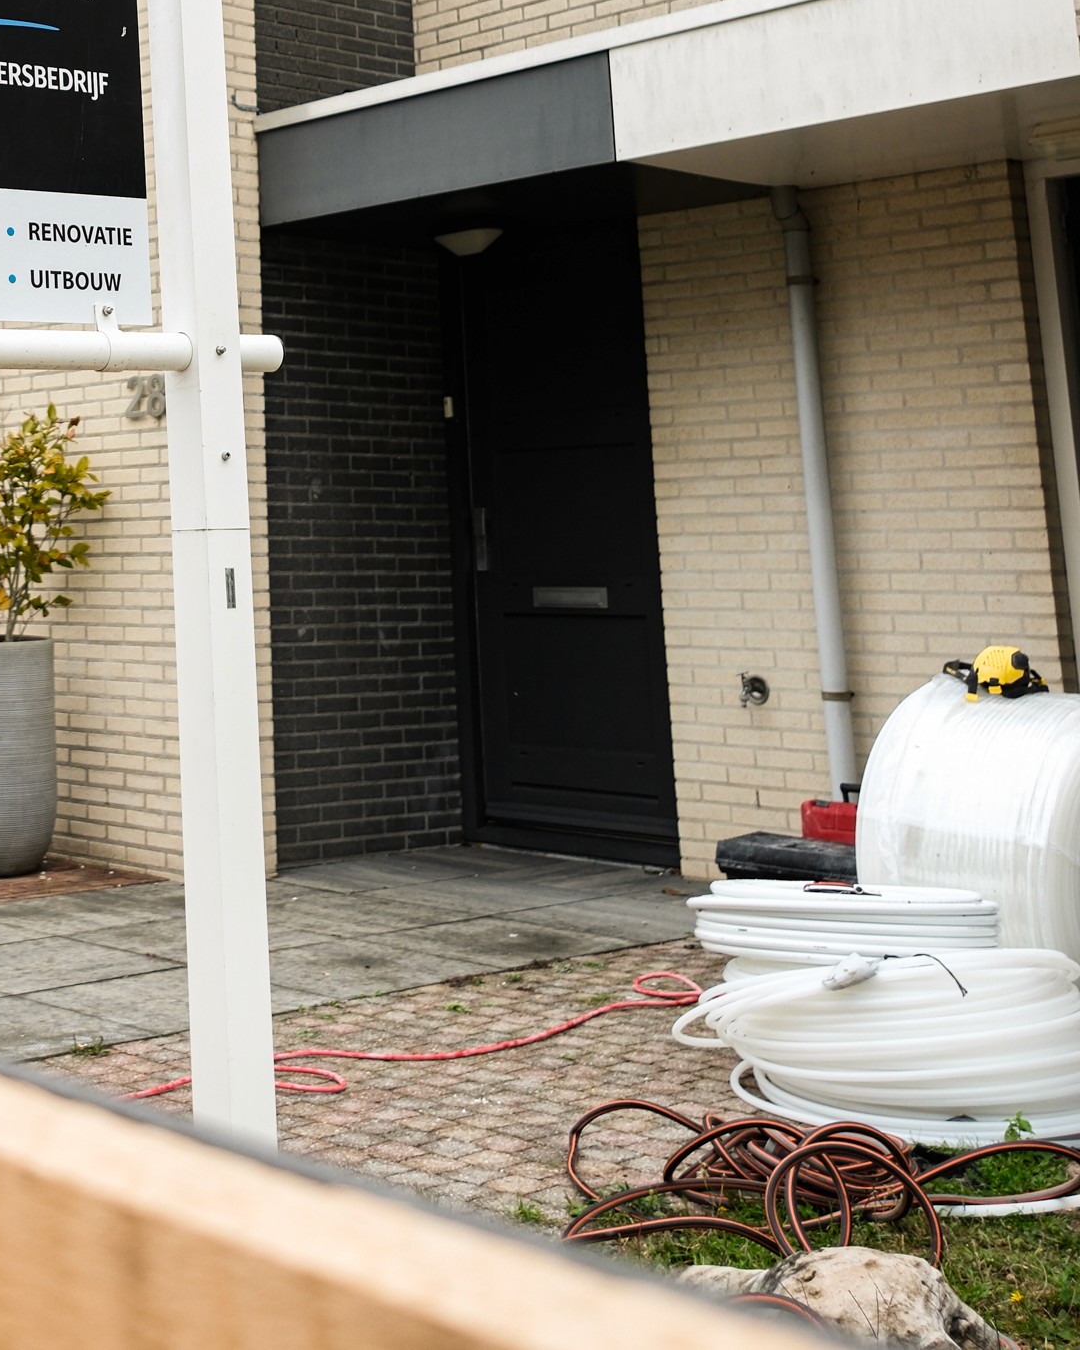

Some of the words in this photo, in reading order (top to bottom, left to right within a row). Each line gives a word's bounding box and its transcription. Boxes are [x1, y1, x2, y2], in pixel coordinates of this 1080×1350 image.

[28, 222, 133, 247] RENOVATIE
[30, 269, 122, 292] UITBOUW
[125, 374, 165, 418] 28
